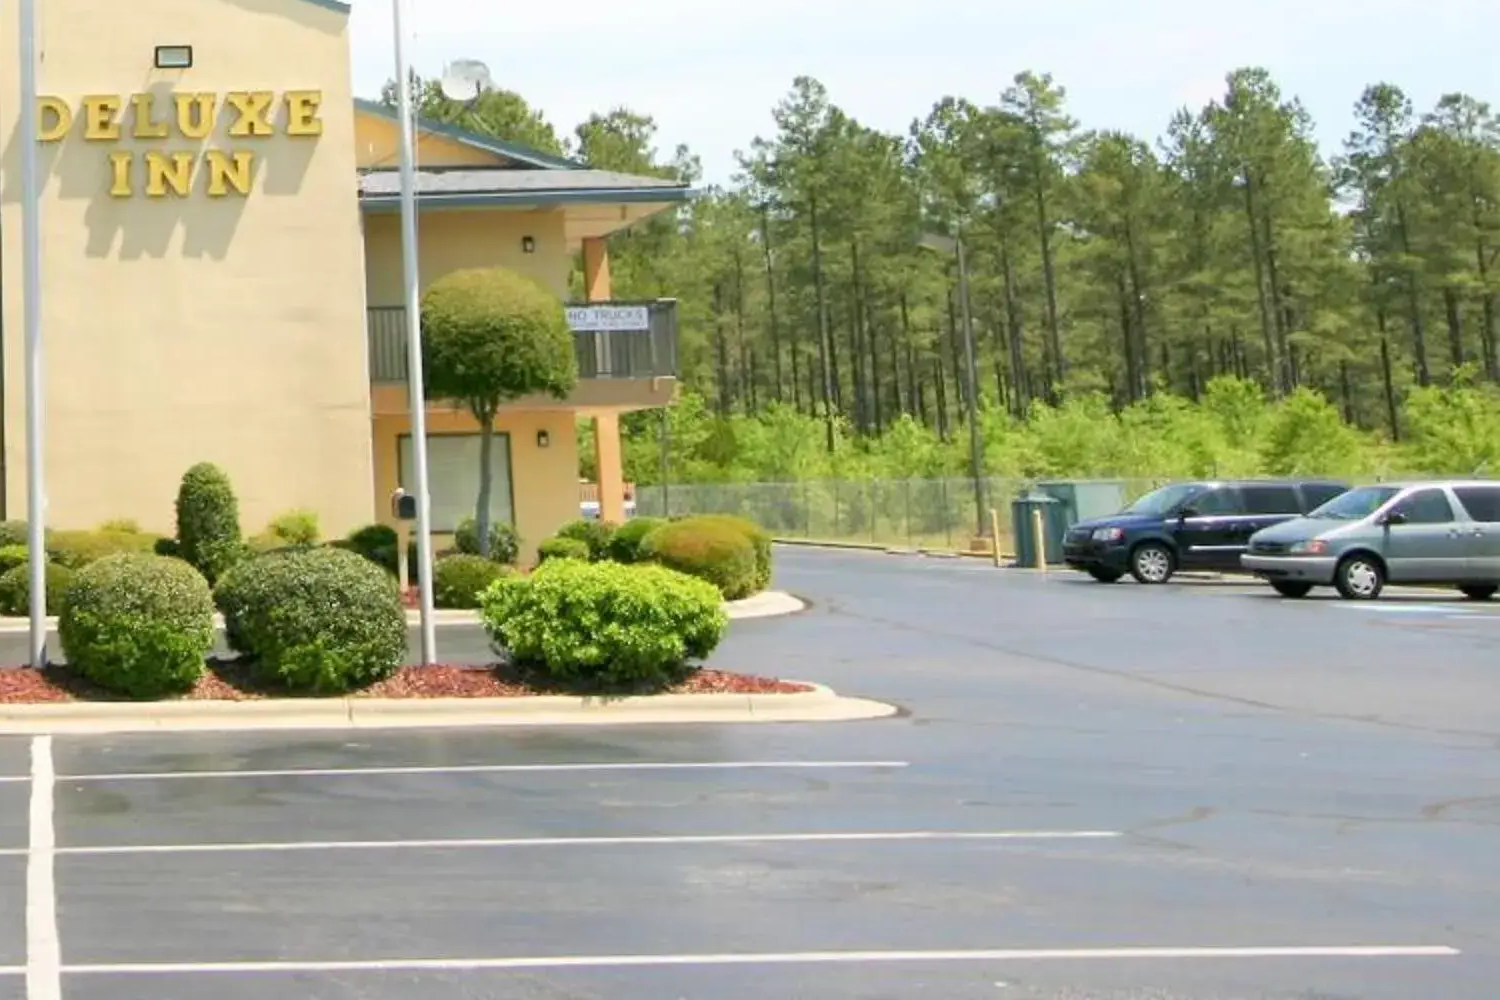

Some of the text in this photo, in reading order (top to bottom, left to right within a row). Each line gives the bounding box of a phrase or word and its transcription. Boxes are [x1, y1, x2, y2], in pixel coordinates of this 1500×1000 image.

[36, 90, 322, 142] DELUXE
[109, 150, 253, 197] INN
[568, 310, 586, 320] NO
